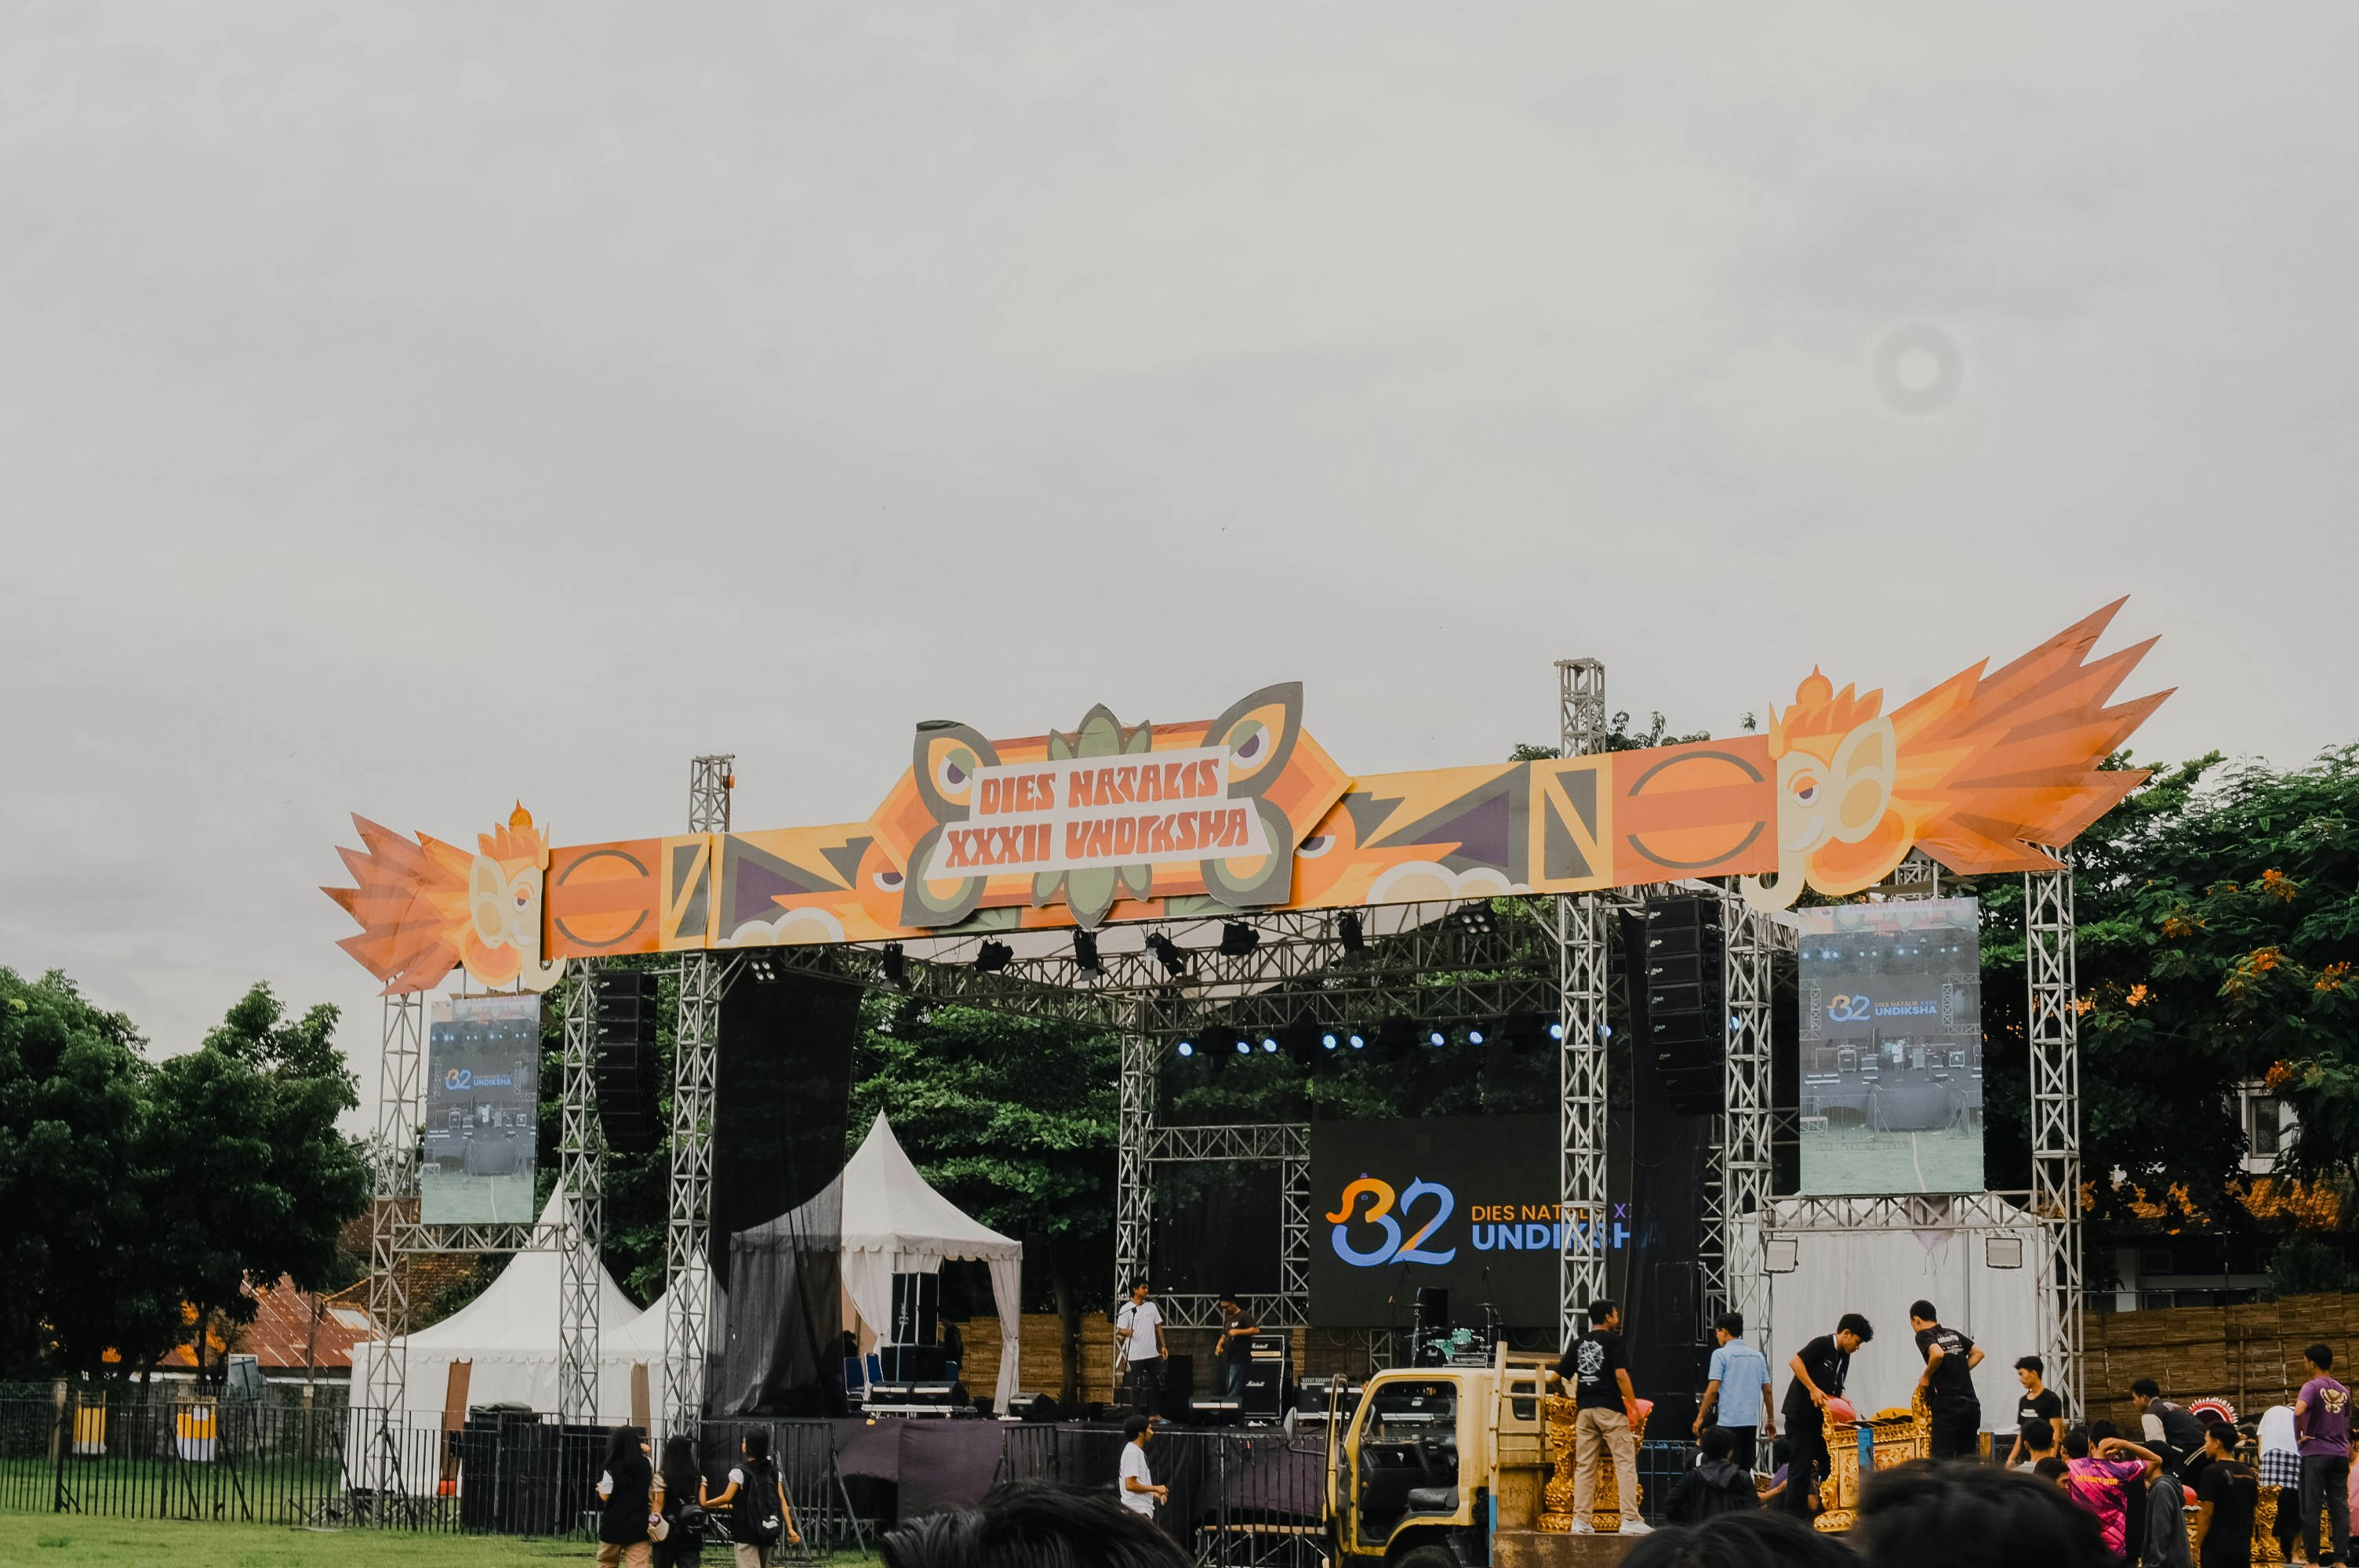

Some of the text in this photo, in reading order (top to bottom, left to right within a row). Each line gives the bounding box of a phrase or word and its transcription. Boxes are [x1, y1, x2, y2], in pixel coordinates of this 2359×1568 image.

[979, 758, 1219, 815] DIES NATALIS
[945, 808, 1249, 869] XXXII UNDIKSHA
[1826, 993, 1870, 1022] 32
[1874, 1006, 1937, 1016] UNDIKSHA
[445, 1068, 471, 1091] 32
[473, 1078, 511, 1087] UNDIKSHA
[1325, 1175, 1456, 1267] 32
[1472, 1205, 1515, 1221] DIES
